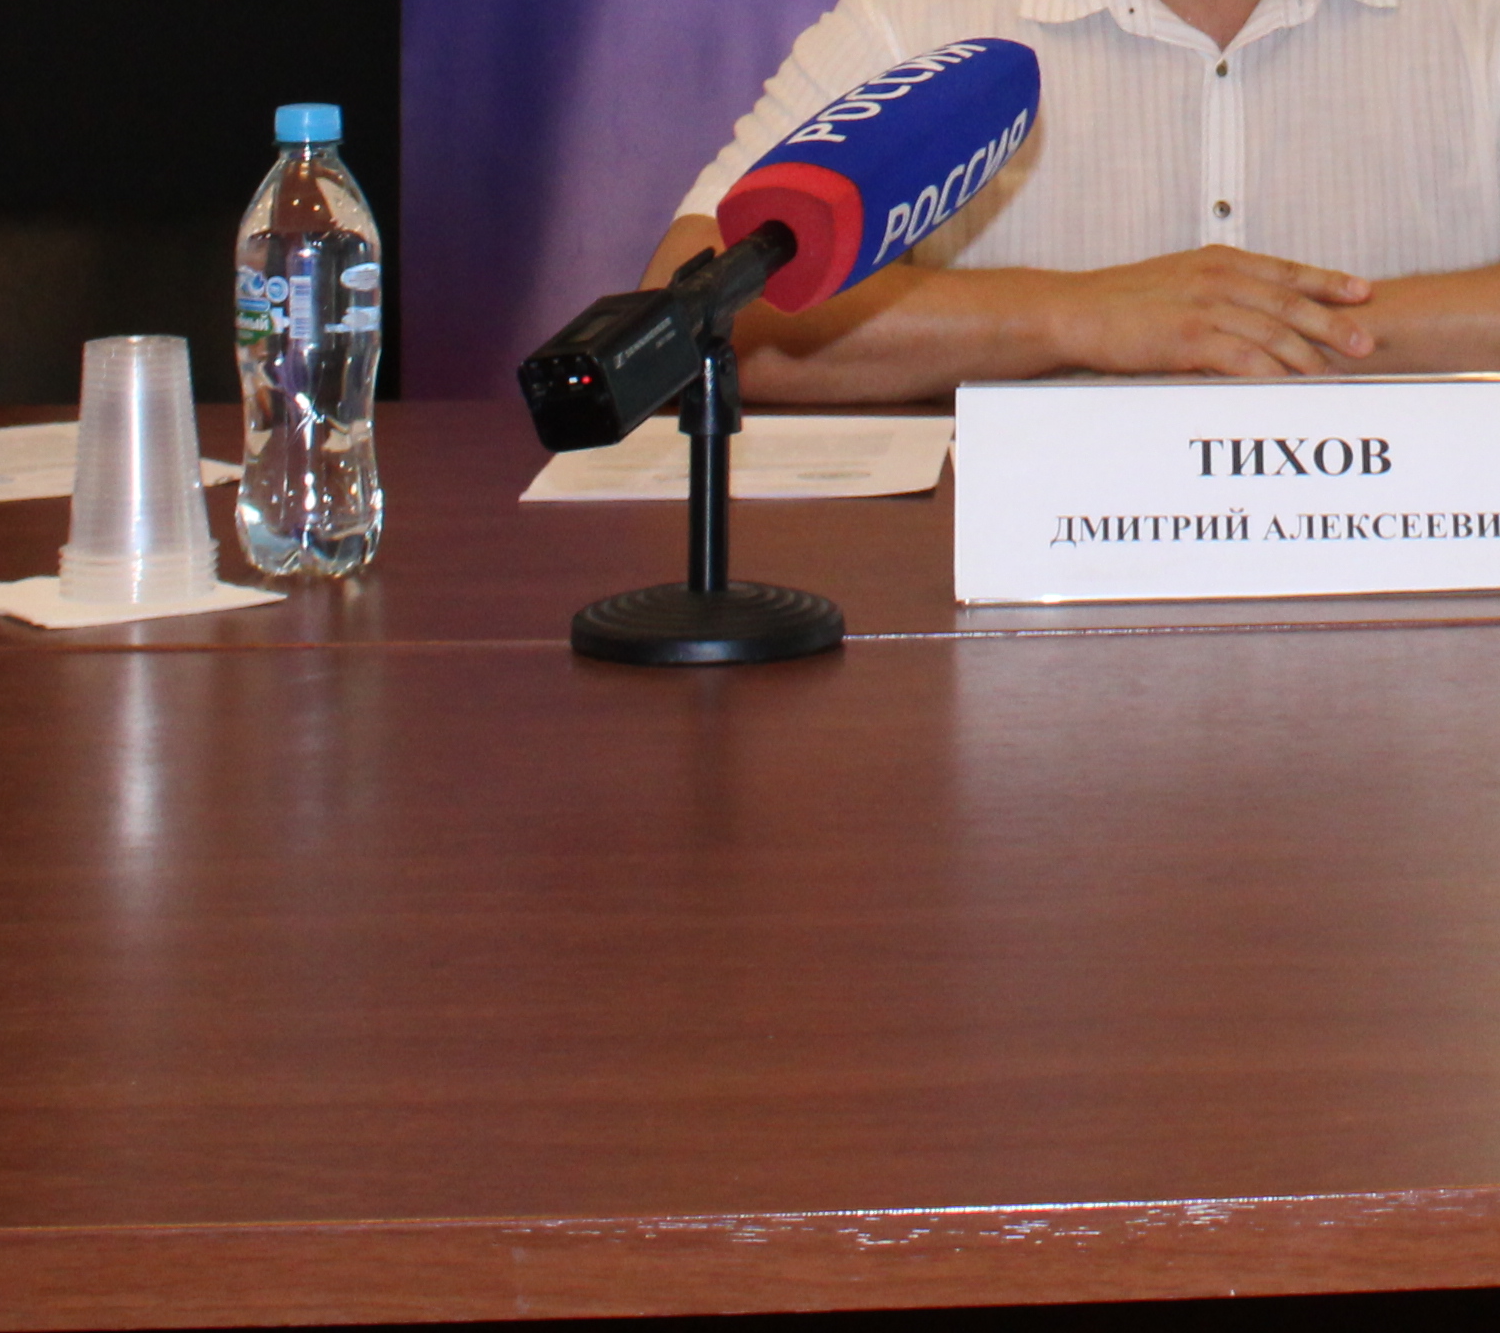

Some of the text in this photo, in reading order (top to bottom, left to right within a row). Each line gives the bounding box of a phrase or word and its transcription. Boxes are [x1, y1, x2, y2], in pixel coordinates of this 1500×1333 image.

[872, 107, 1028, 265] РОССИЯ
[1189, 437, 1393, 477] ТИХОВ
[1050, 508, 1250, 547] ДМИТРИЙ
